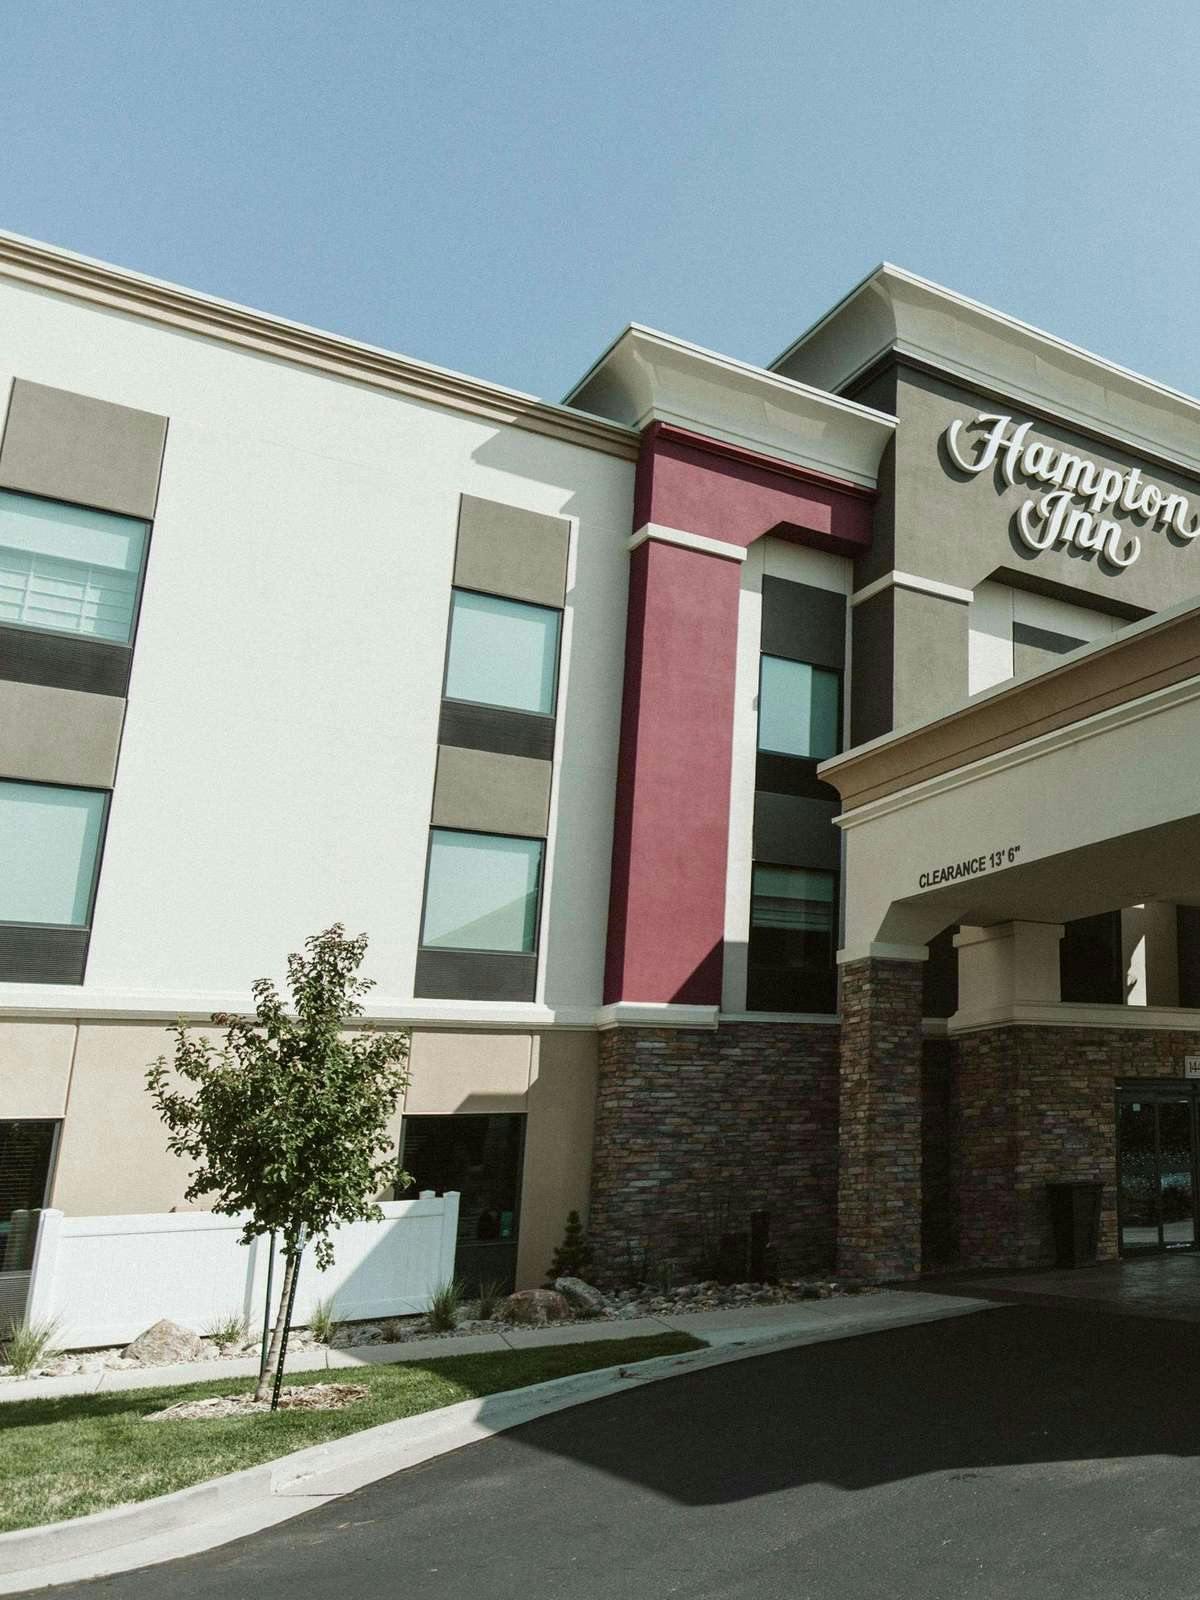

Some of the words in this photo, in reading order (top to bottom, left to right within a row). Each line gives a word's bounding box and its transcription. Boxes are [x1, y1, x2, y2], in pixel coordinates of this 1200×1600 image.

[1016, 490, 1141, 568] Inn
[919, 856, 986, 888] CLEARANCE
[989, 849, 1005, 868] 13'
